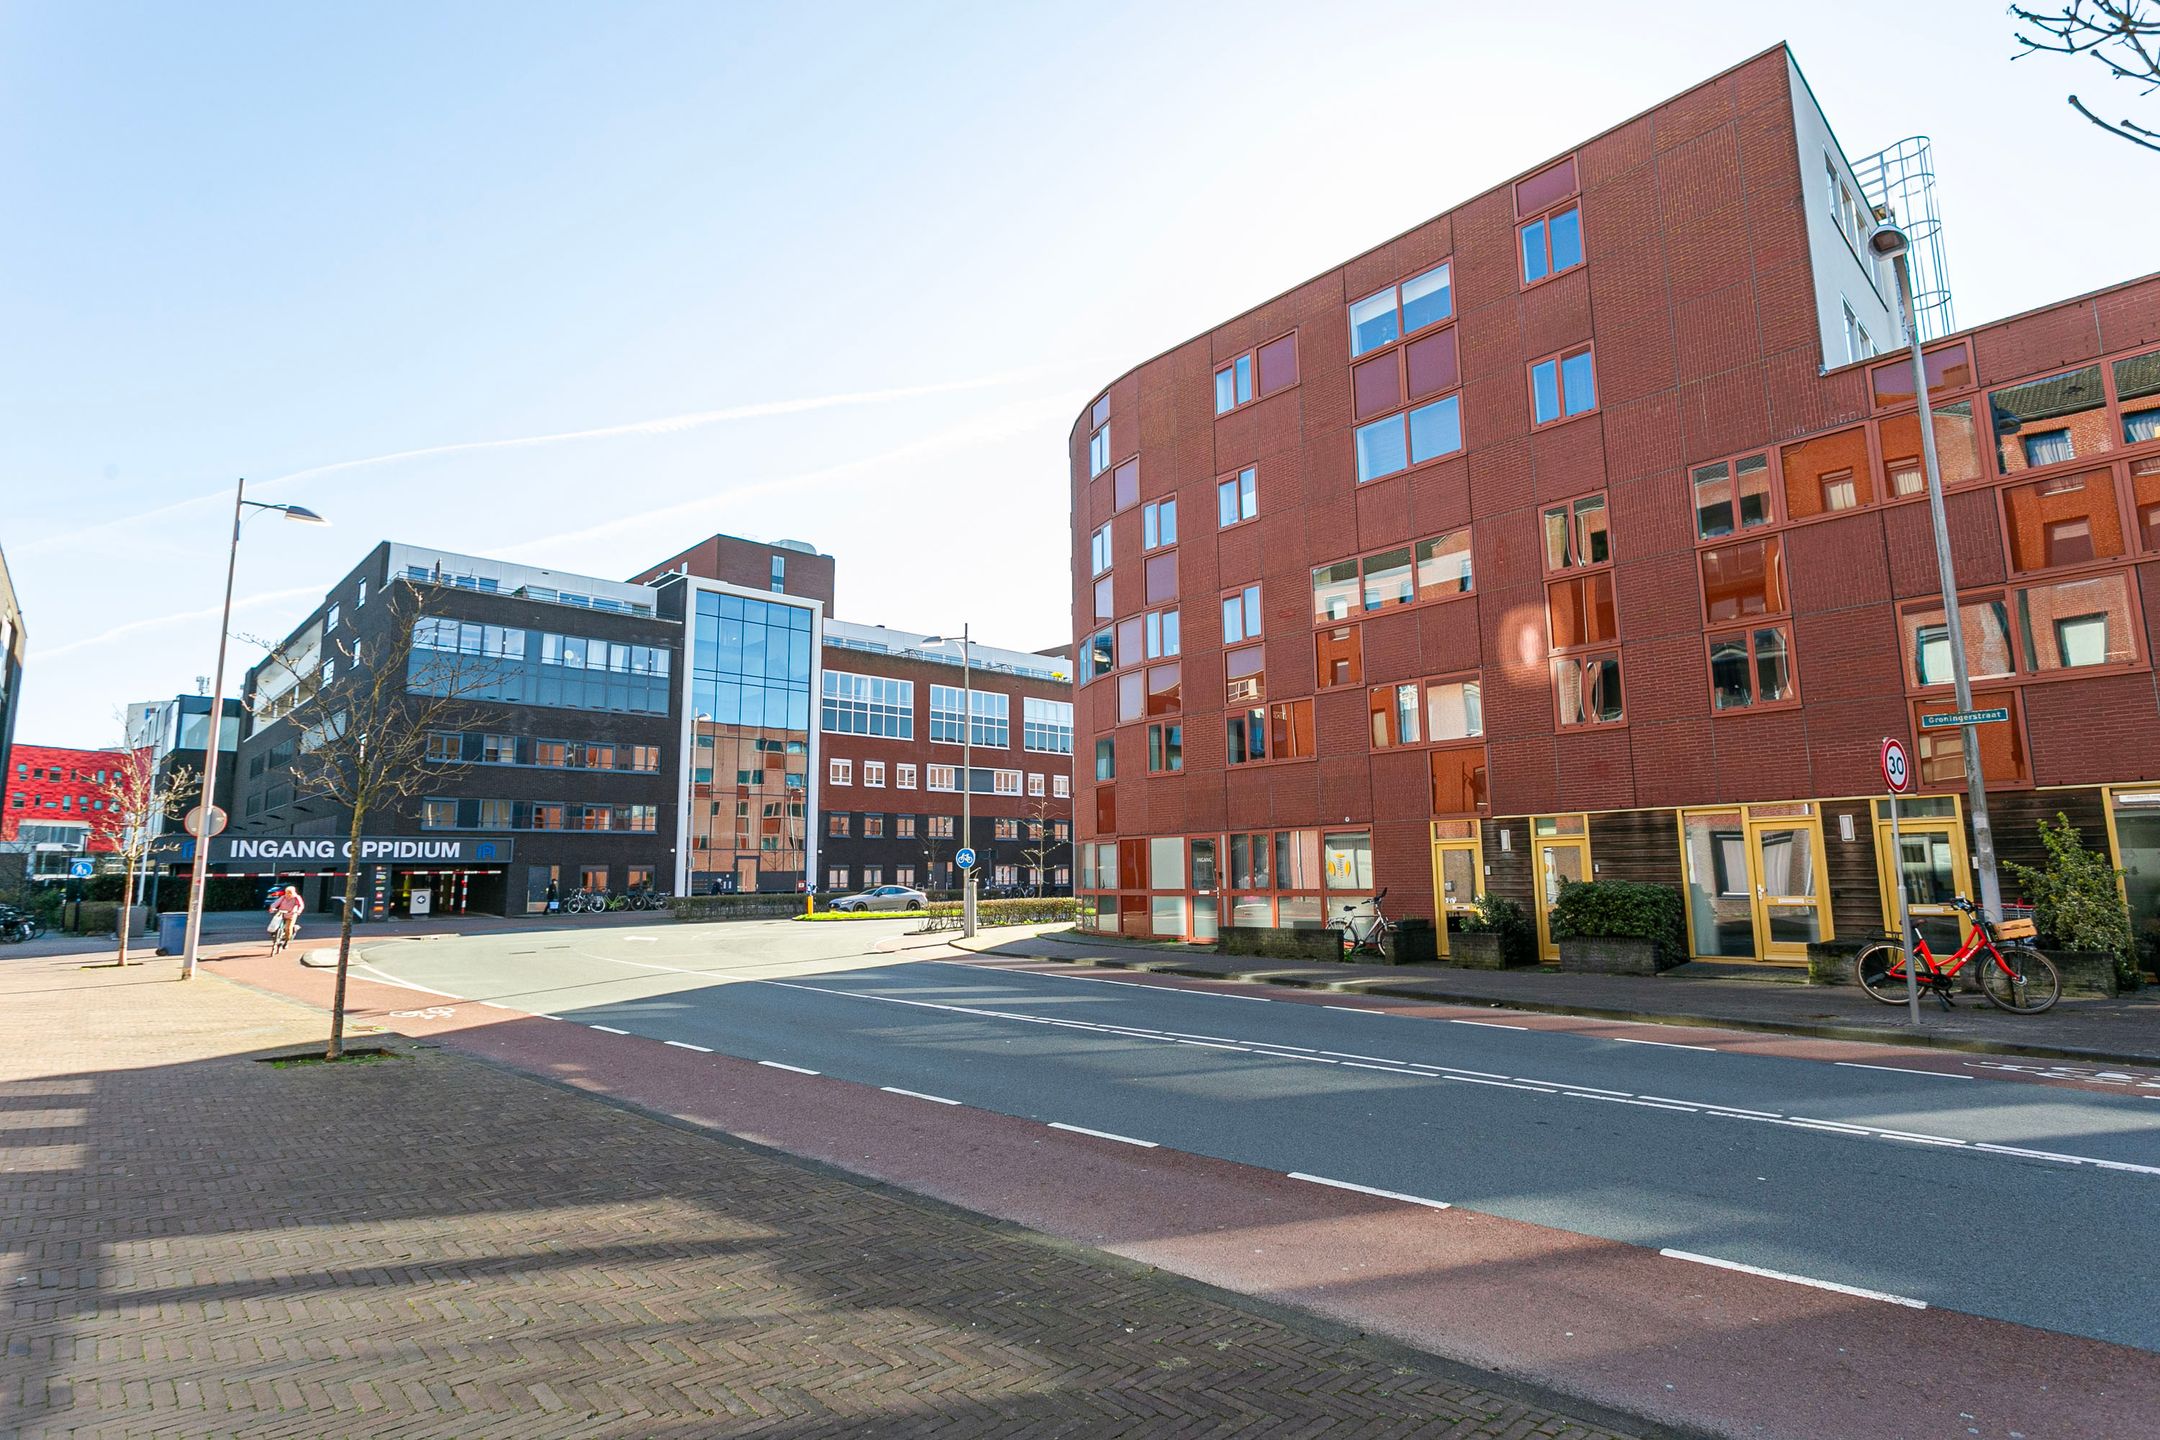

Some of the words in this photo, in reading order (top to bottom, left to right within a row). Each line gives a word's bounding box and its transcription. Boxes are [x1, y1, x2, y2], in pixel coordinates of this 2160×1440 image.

[1927, 711, 2002, 724] Groningerstraat
[1888, 756, 1904, 776] 30
[230, 839, 335, 858] INGANG
